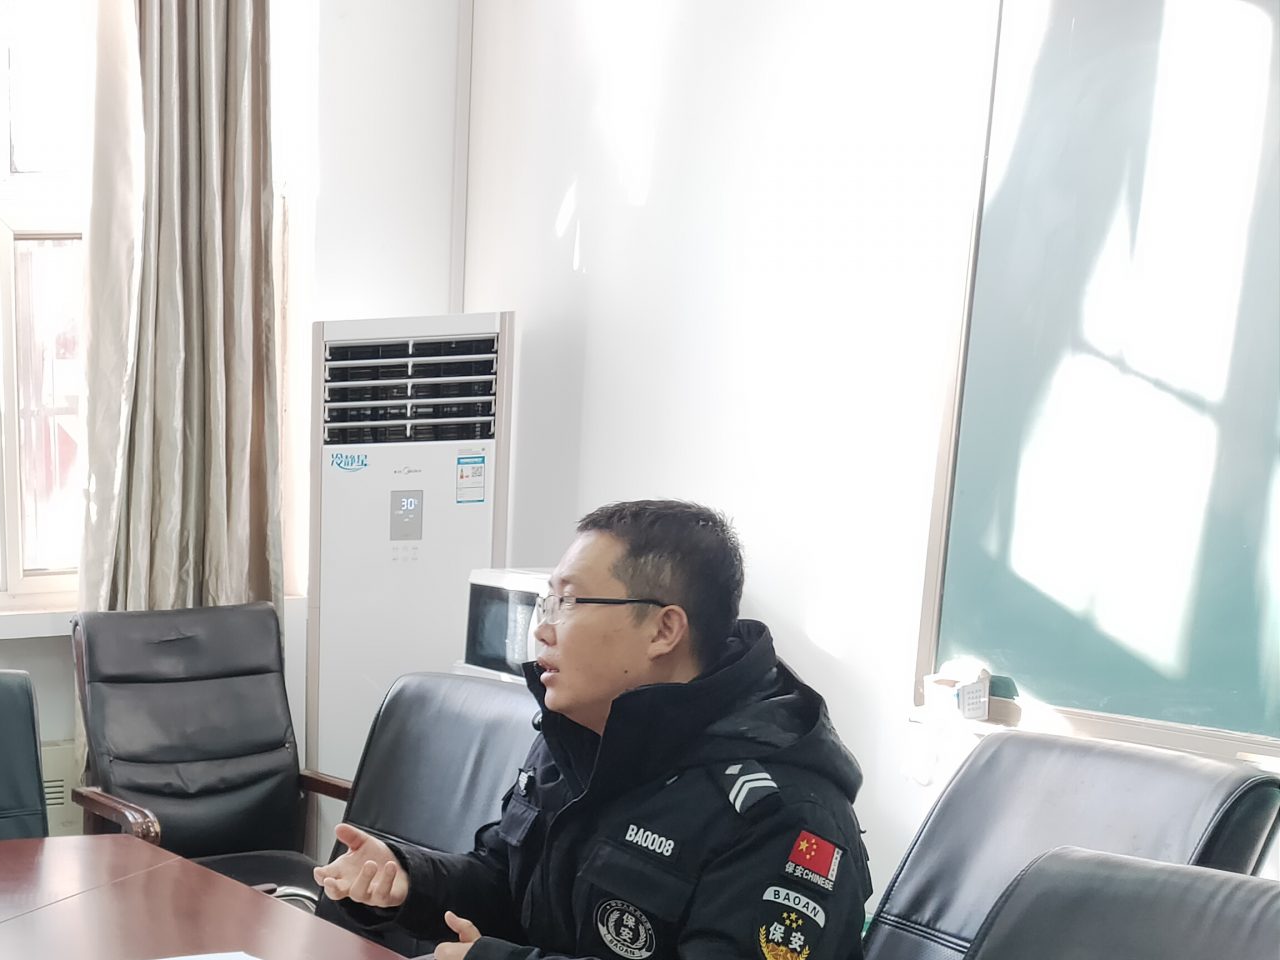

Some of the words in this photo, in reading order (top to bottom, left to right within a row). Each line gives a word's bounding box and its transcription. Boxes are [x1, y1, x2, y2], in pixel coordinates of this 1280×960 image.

[625, 824, 675, 857] BA0008
[773, 889, 820, 918] BAOAN
[620, 912, 636, 942] 保安
[768, 921, 805, 952] 保安
